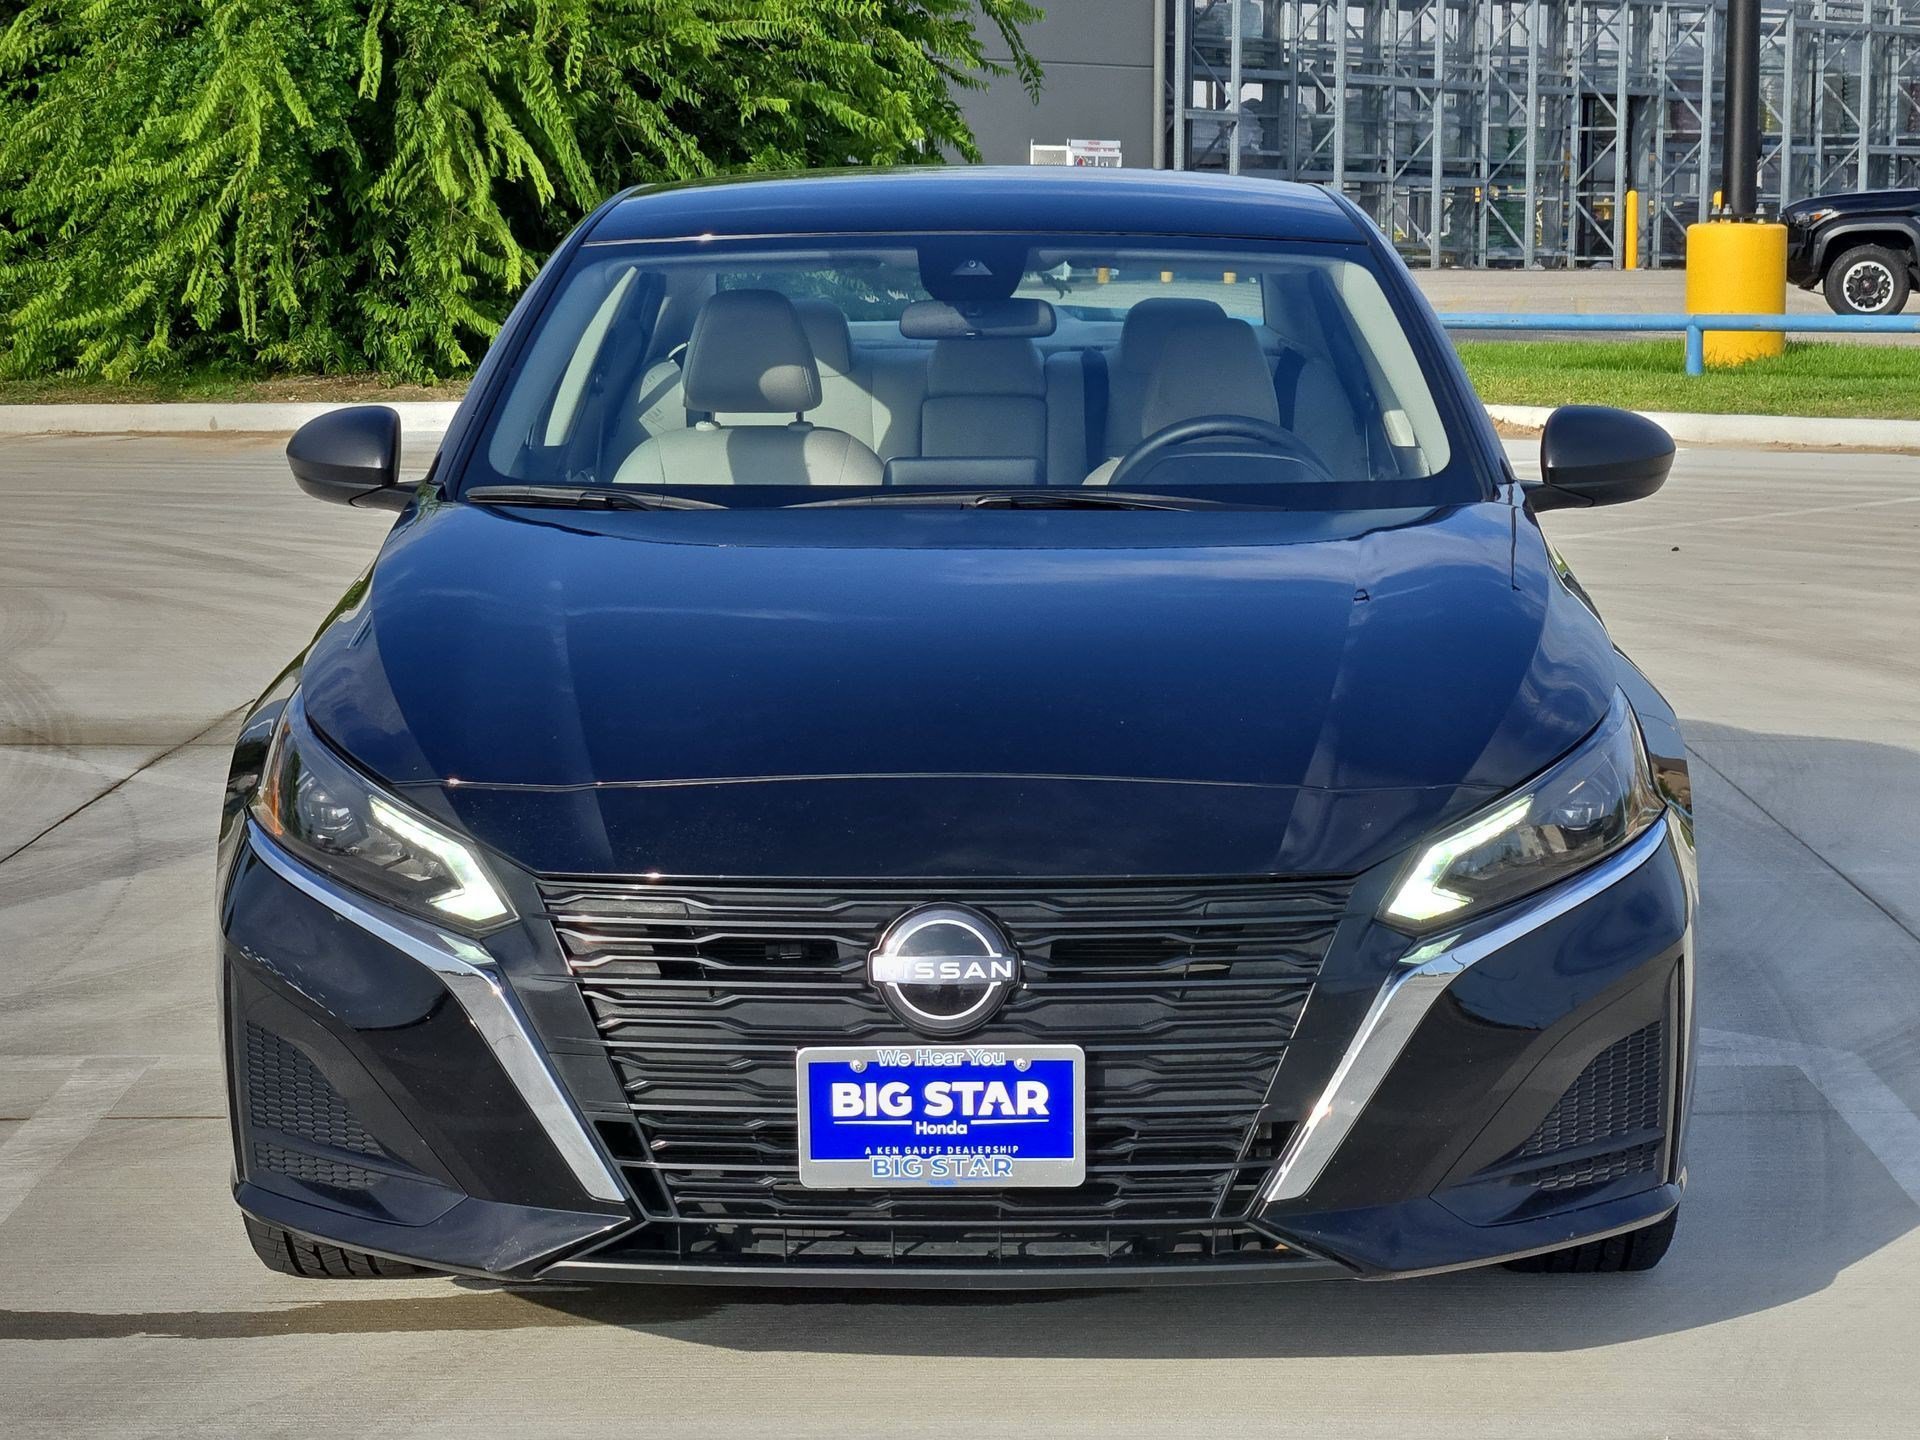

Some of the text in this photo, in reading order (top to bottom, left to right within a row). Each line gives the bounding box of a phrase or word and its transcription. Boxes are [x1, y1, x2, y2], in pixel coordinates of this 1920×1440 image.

[877, 1049, 1006, 1067] We Hear You
[832, 1081, 1049, 1117] BIG STAR
[915, 1120, 968, 1135] Honda
[864, 1145, 1019, 1155] A KEN GARFF DEALERSHIP
[871, 1155, 1013, 1177] BIG STAR
